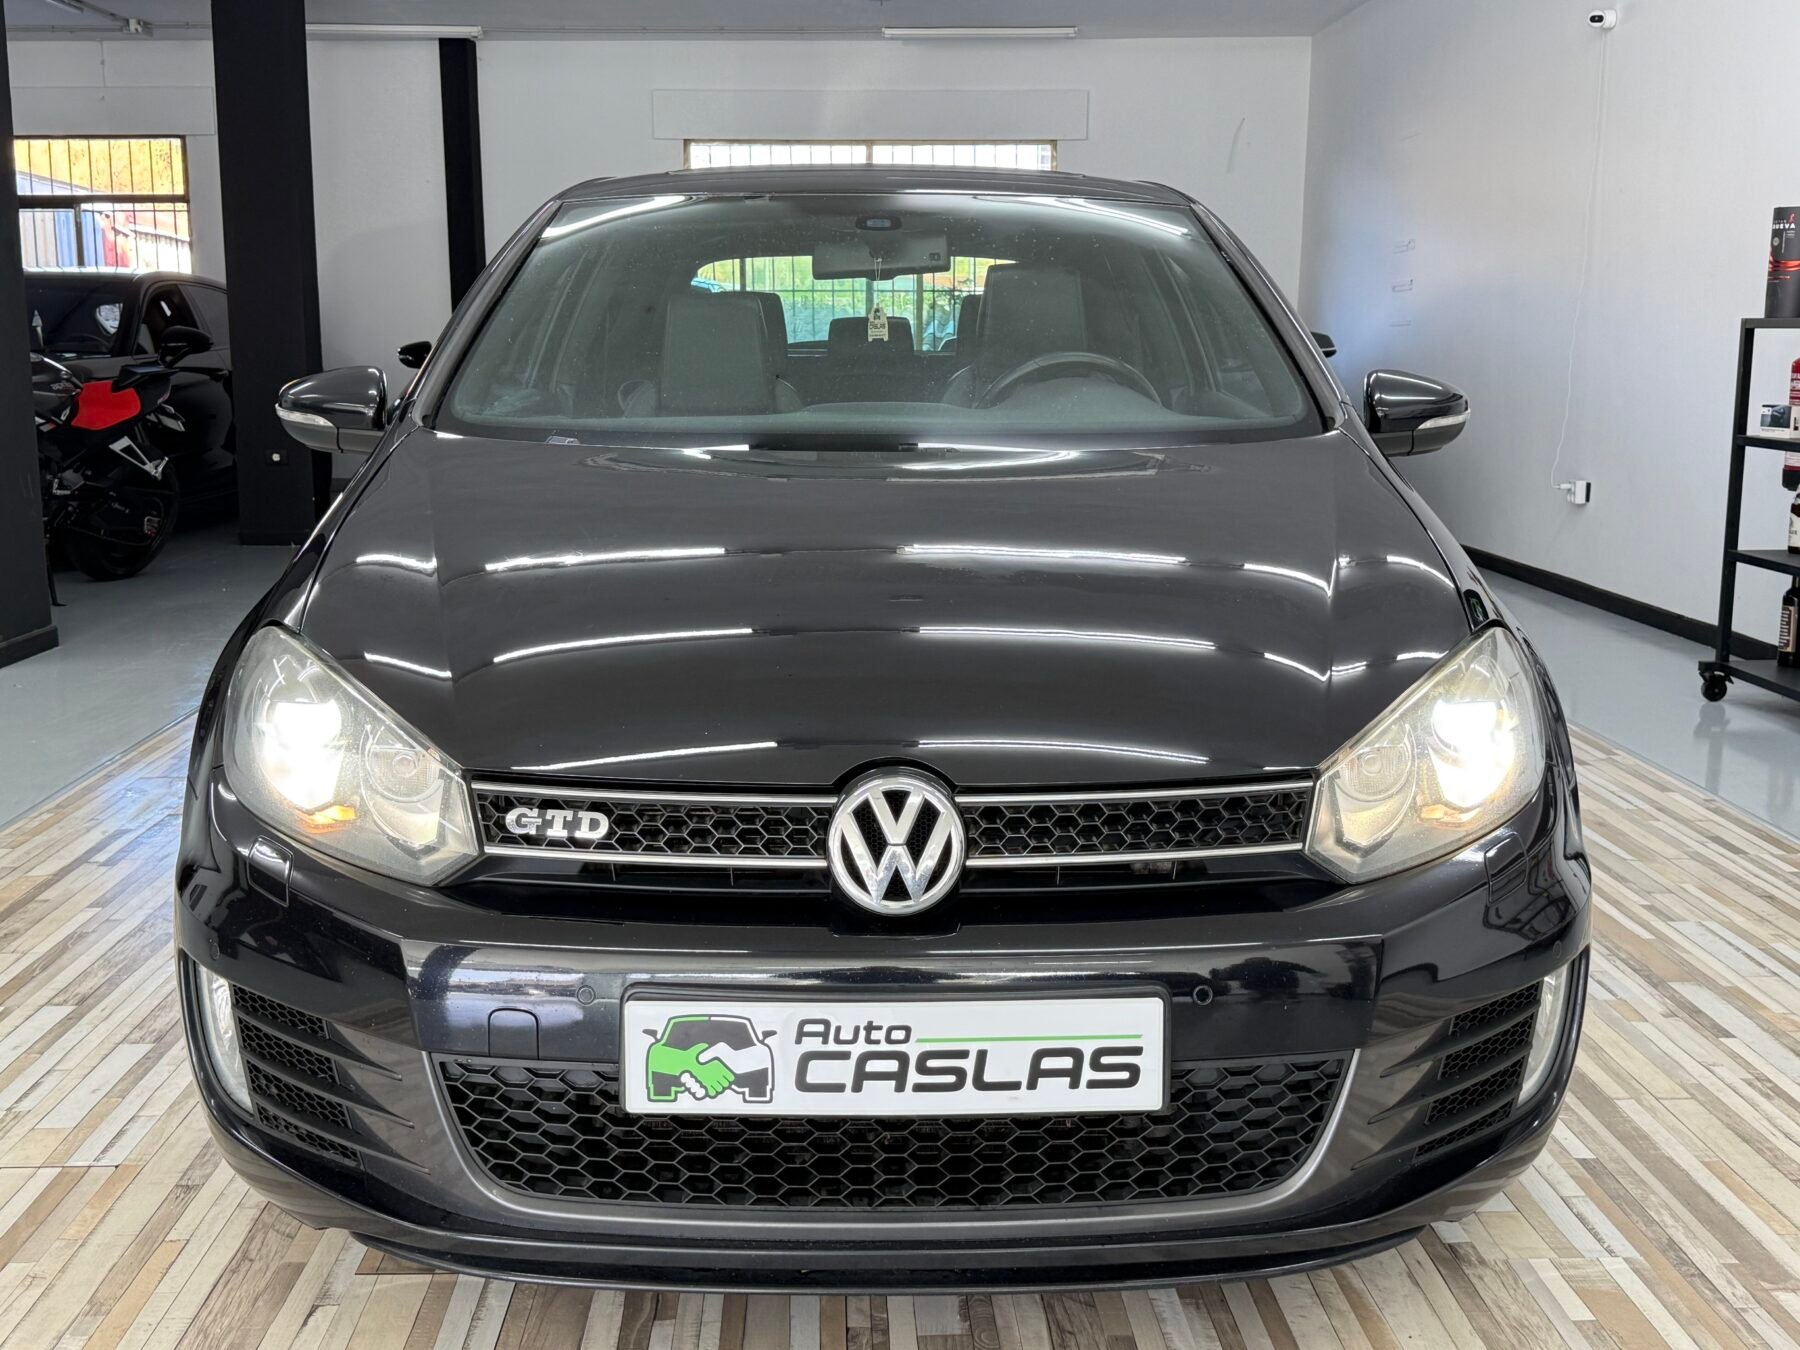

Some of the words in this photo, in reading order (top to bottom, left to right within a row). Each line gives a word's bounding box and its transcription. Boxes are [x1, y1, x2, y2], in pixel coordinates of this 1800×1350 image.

[505, 807, 609, 843] GTD
[842, 786, 956, 905] VW
[795, 1018, 912, 1045] Auto
[795, 1046, 1144, 1093] CASLAS
